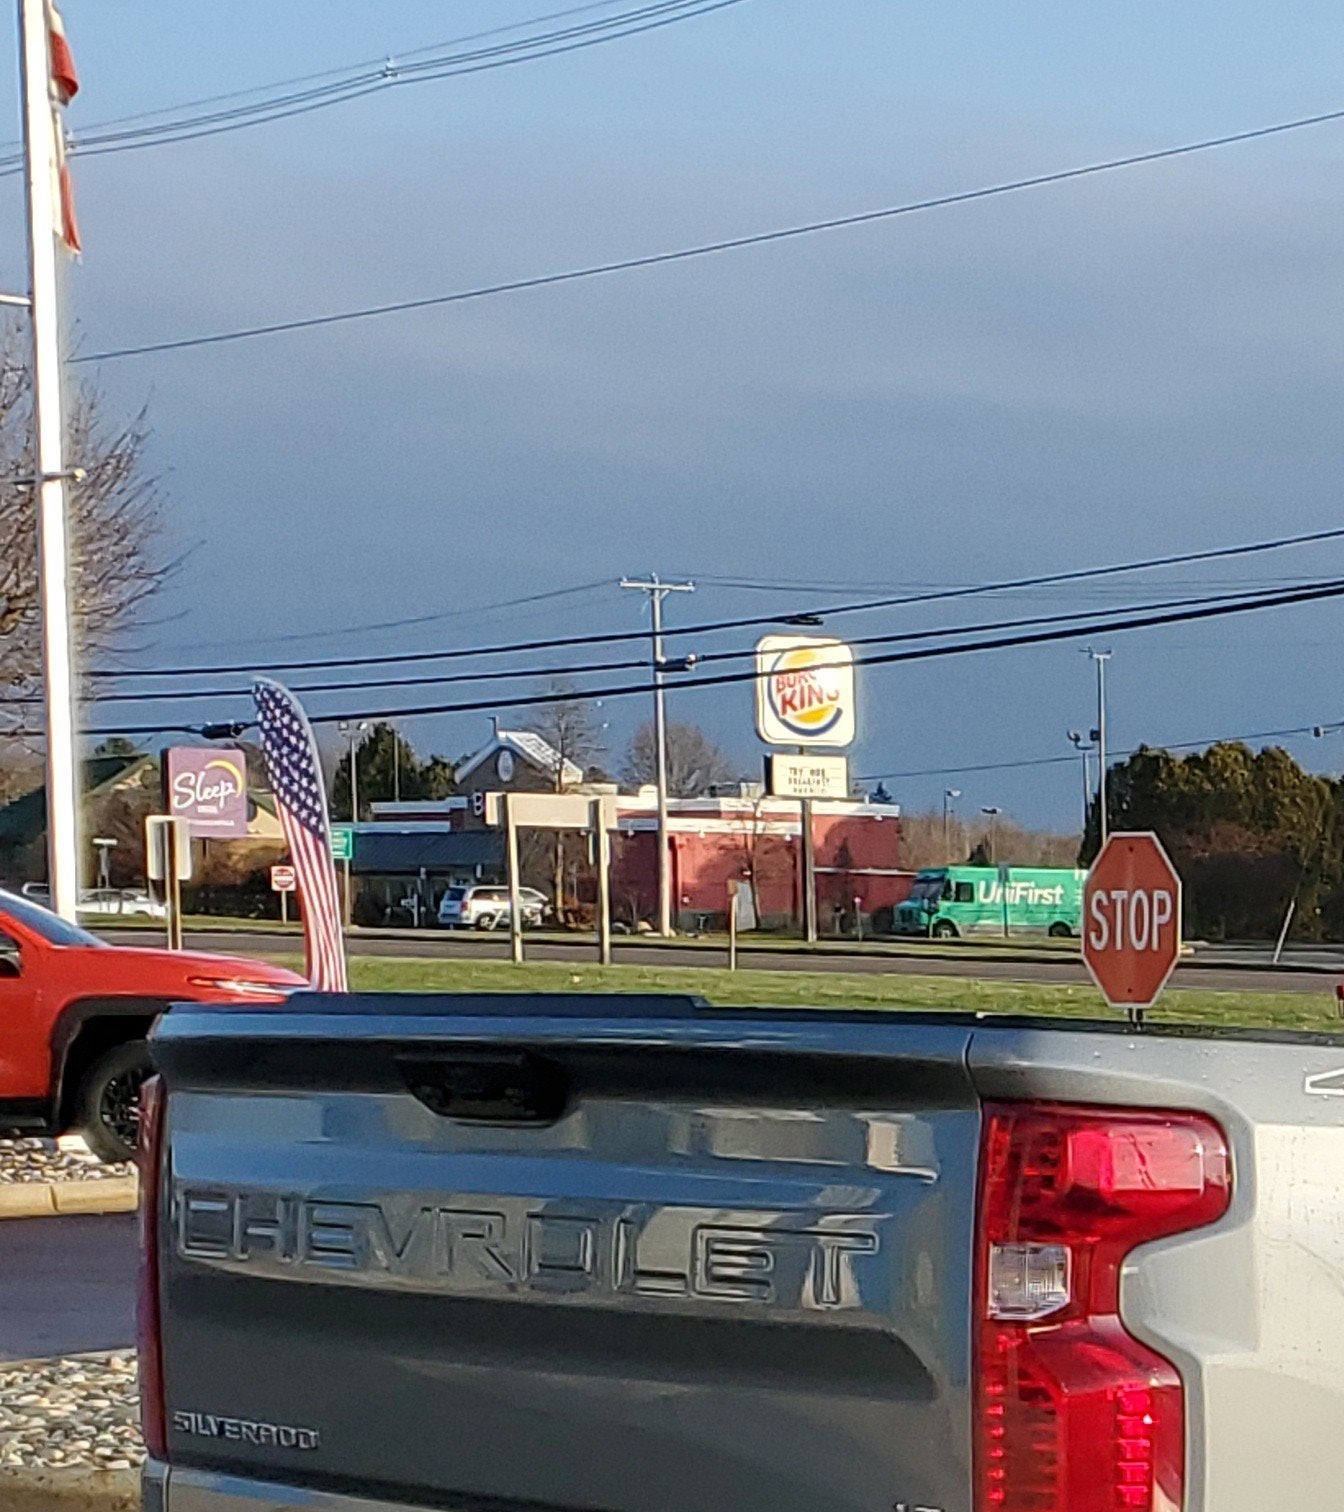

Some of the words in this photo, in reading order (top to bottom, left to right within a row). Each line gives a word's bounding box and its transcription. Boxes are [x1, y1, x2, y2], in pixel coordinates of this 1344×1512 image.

[174, 771, 236, 809] Sleep
[979, 880, 1065, 905] UniFirst
[1089, 889, 1173, 951] STOP
[177, 1191, 879, 1309] CHEVROLET
[174, 1410, 321, 1449] SILVERADO
